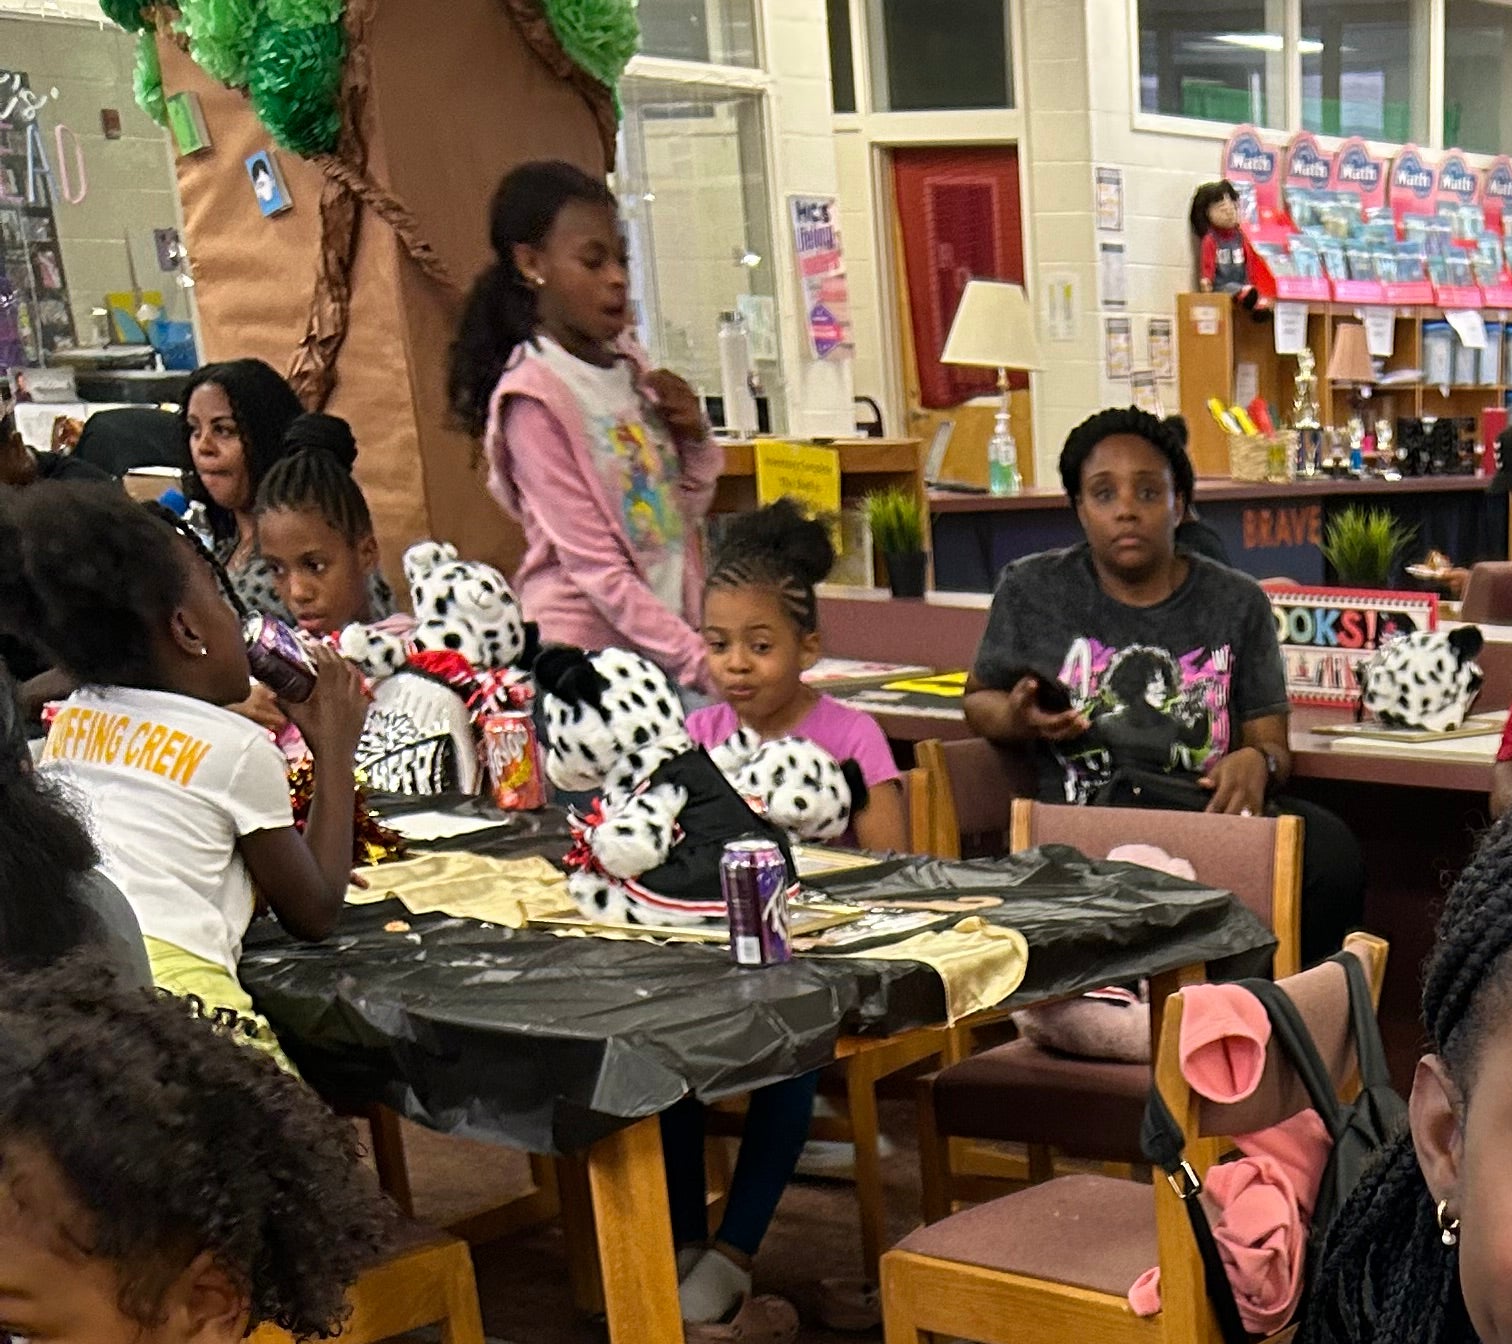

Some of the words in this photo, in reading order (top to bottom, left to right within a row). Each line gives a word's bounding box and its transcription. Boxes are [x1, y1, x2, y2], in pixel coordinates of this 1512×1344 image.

[1243, 505, 1322, 549] BRAVE
[1271, 605, 1378, 650] OOKS!
[123, 721, 213, 788] CREW
